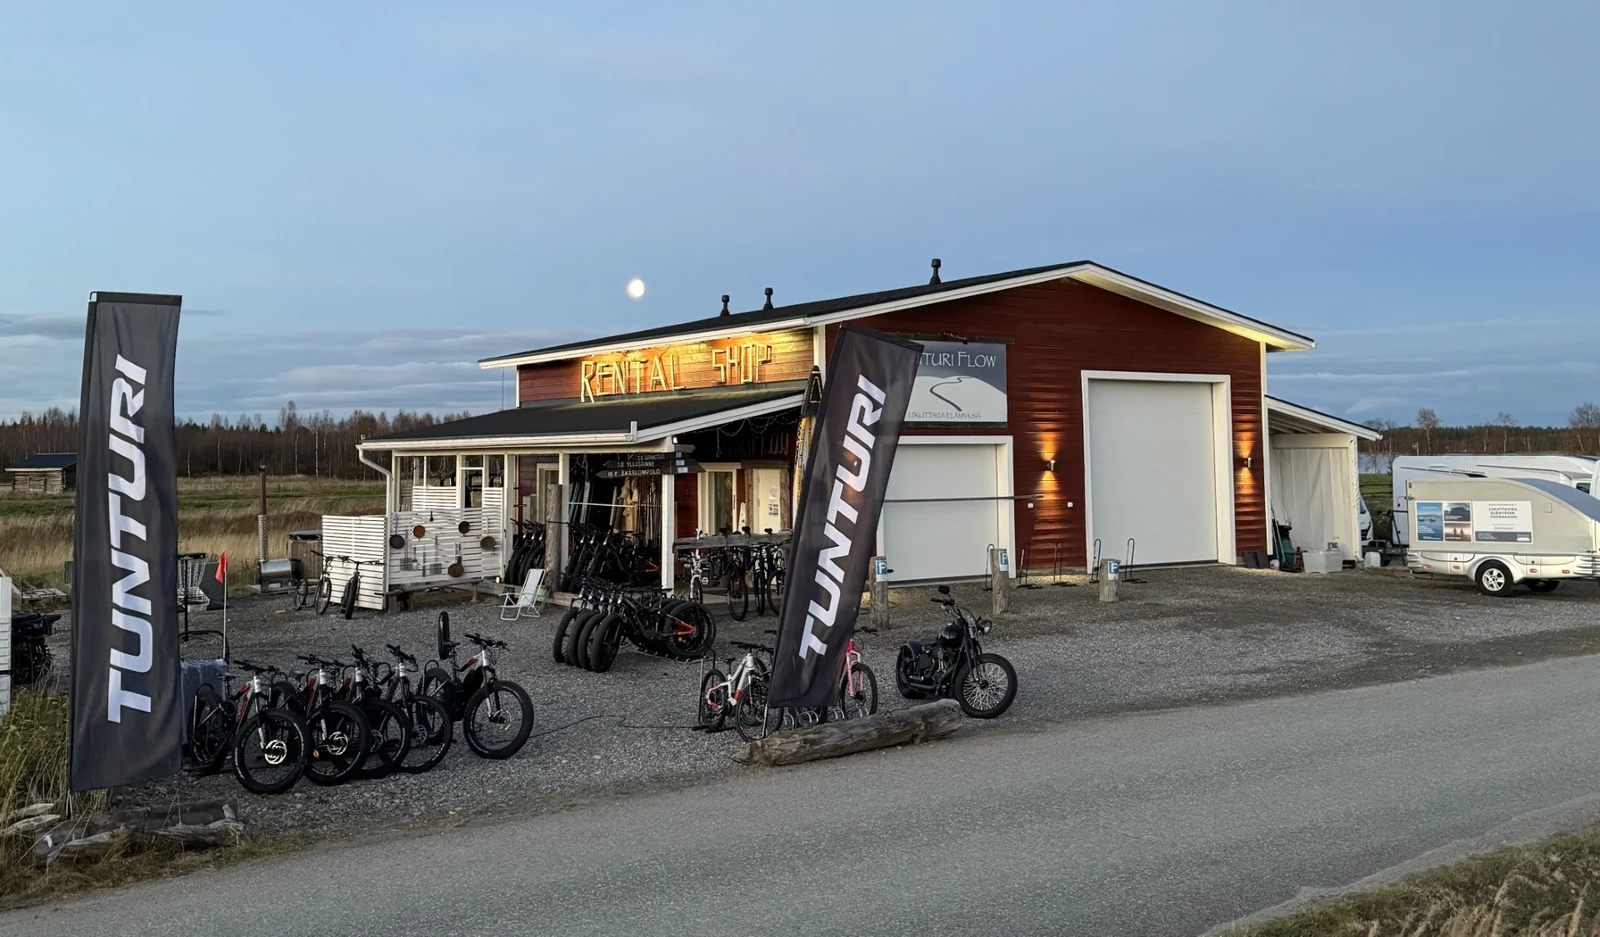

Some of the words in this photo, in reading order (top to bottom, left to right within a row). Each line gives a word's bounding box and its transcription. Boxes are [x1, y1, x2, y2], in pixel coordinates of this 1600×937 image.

[581, 354, 687, 403] RENTAL
[711, 343, 772, 385] SHOP
[919, 352, 954, 367] TURI
[958, 351, 997, 368] FLOW
[107, 353, 154, 724] TUNTURI
[799, 373, 887, 660] TUNTURI
[1111, 562, 1119, 574] P
